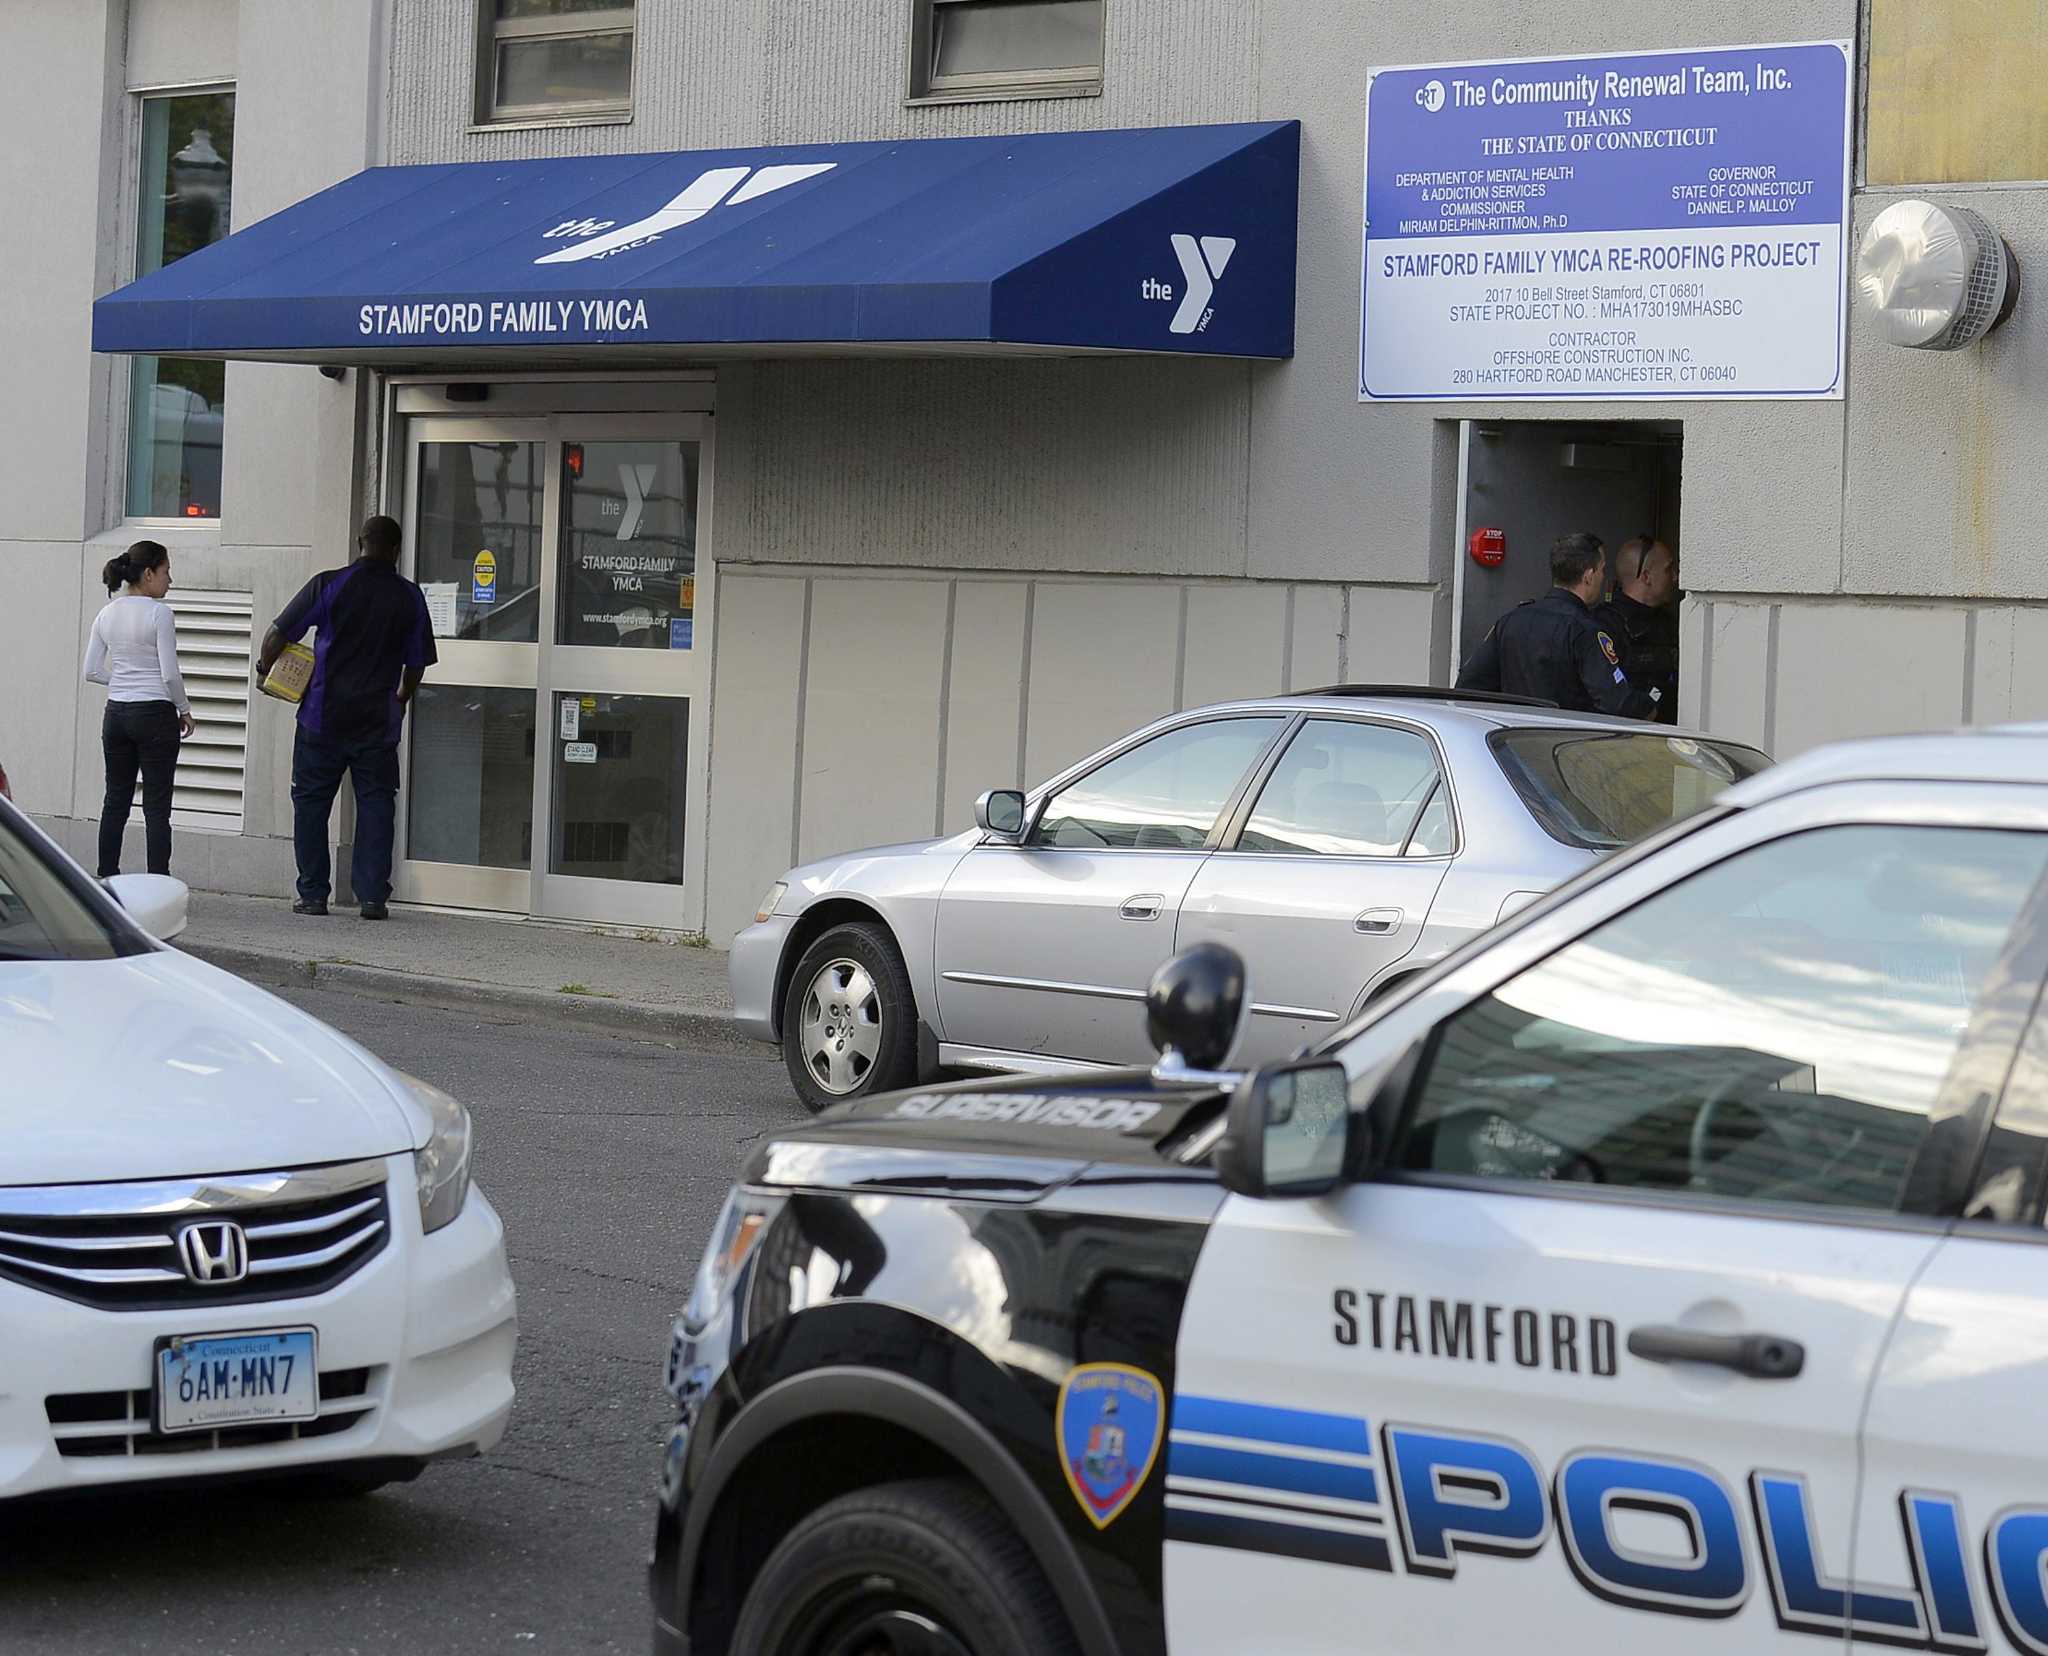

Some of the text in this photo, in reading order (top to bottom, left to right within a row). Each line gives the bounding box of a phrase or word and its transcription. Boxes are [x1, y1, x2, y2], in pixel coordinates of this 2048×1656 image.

[1453, 80, 1486, 107] The
[1492, 74, 1599, 107] Community
[1605, 68, 1686, 98] Renewal
[1692, 67, 1750, 96] Team,
[1757, 63, 1792, 91] Inc.
[1564, 108, 1632, 128] THANKS
[1481, 128, 1718, 155] THE STATE OF CONNECTICUT
[1396, 166, 1573, 187] DEPARTMENT OF MENTAL HEALTH
[1709, 166, 1775, 181] GOVERNOR
[1421, 184, 1545, 201] & ADDICTION SERVICES
[1672, 181, 1813, 199] STATE OF CONNECTICUT
[1441, 201, 1525, 216] COMMISSIONER
[1688, 199, 1796, 214] DANNEL P. MALLOY
[1400, 215, 1567, 233] MIRIAM DELPHIN-RITTMON, Ph.D
[592, 234, 662, 259] YMCA
[1384, 242, 1820, 277] STAMFORD FAMILY YMCA RE-ROOFING PROJECT
[1142, 278, 1171, 300] the
[1485, 284, 1704, 302] 2017 10 Bell Street Stamford, CT 06801
[359, 299, 648, 334] STAMFORD FAMILY YMCA
[1197, 307, 1214, 332] YMCA
[1450, 306, 1491, 321] STATE
[1495, 304, 1560, 321] PROJECT
[1601, 300, 1743, 319] MHA173019MHASBC
[1549, 332, 1636, 346] CONTRACTOR
[1494, 348, 1694, 365] OFFSHORE CONSTRUCTION INC.
[1453, 366, 1736, 383] 280 HARTFORD ROAD MANCHESTER, CT 06040
[602, 499, 620, 516] the
[582, 556, 675, 571] STAMFORD FAMILY
[613, 577, 643, 591] YMCA
[583, 613, 667, 628] www.stamfordymca.org
[882, 1094, 1162, 1131] SUPERVISOR
[1334, 1289, 1618, 1378] STAMFORD
